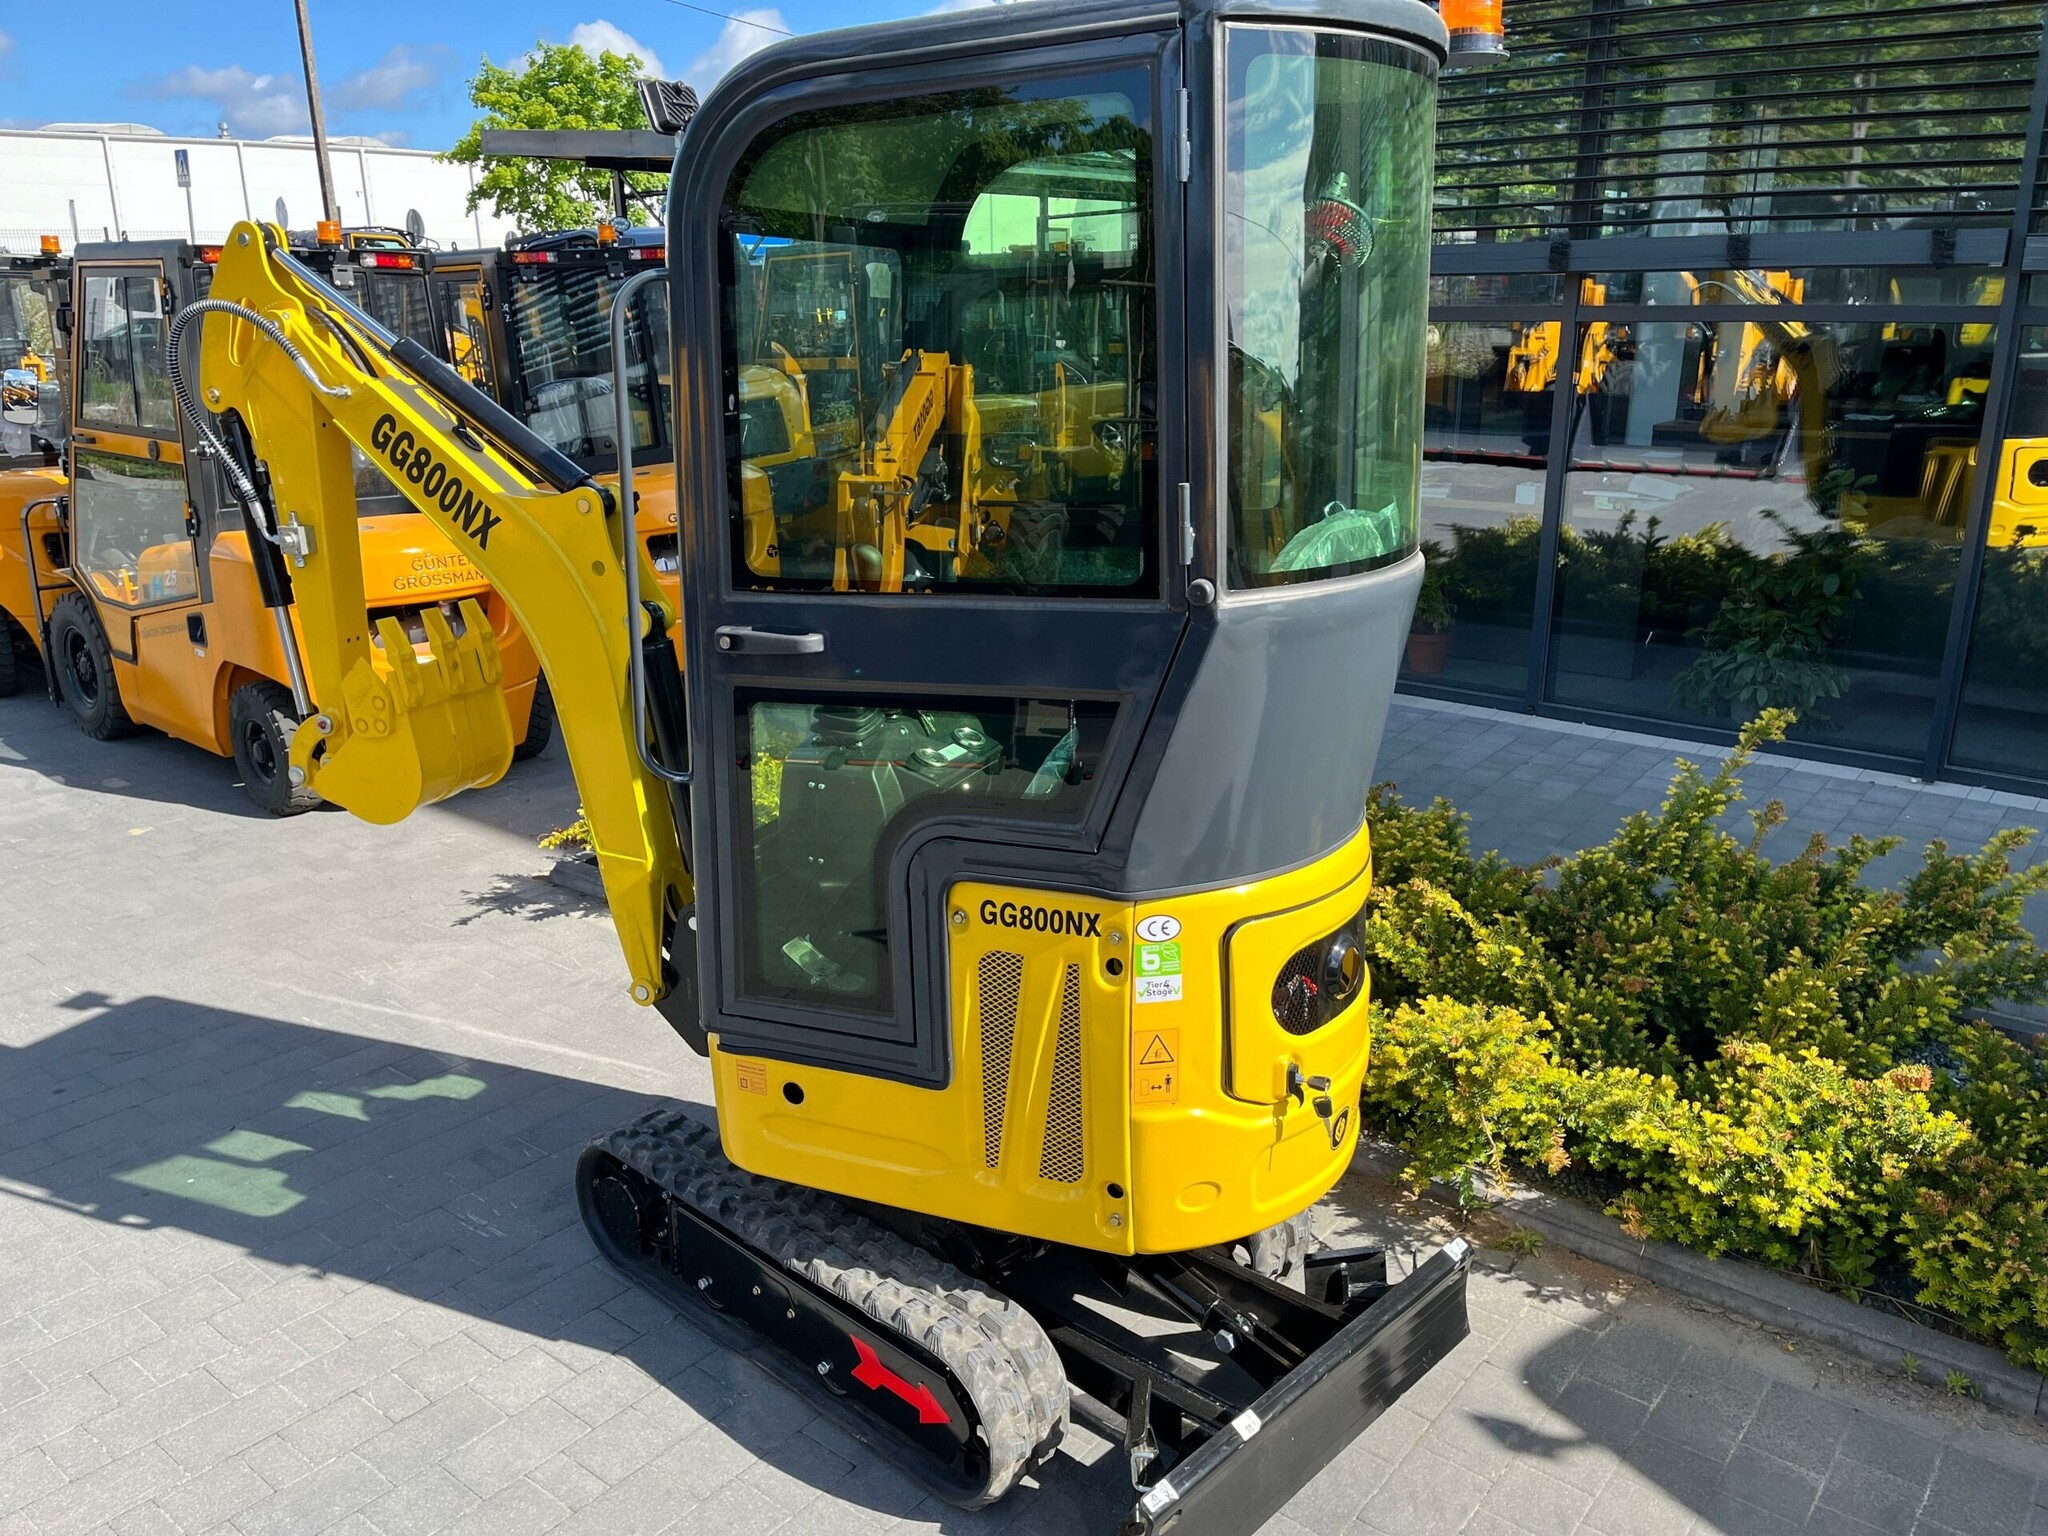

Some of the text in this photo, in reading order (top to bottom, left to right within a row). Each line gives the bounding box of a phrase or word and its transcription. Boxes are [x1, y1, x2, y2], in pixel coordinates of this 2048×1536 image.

[371, 413, 502, 551] GG800NX
[164, 569, 178, 586] 25
[979, 899, 1102, 938] GG800NX
[1147, 920, 1170, 937] CE
[1146, 980, 1170, 989] Tier 4
[1146, 988, 1173, 998] Stage
